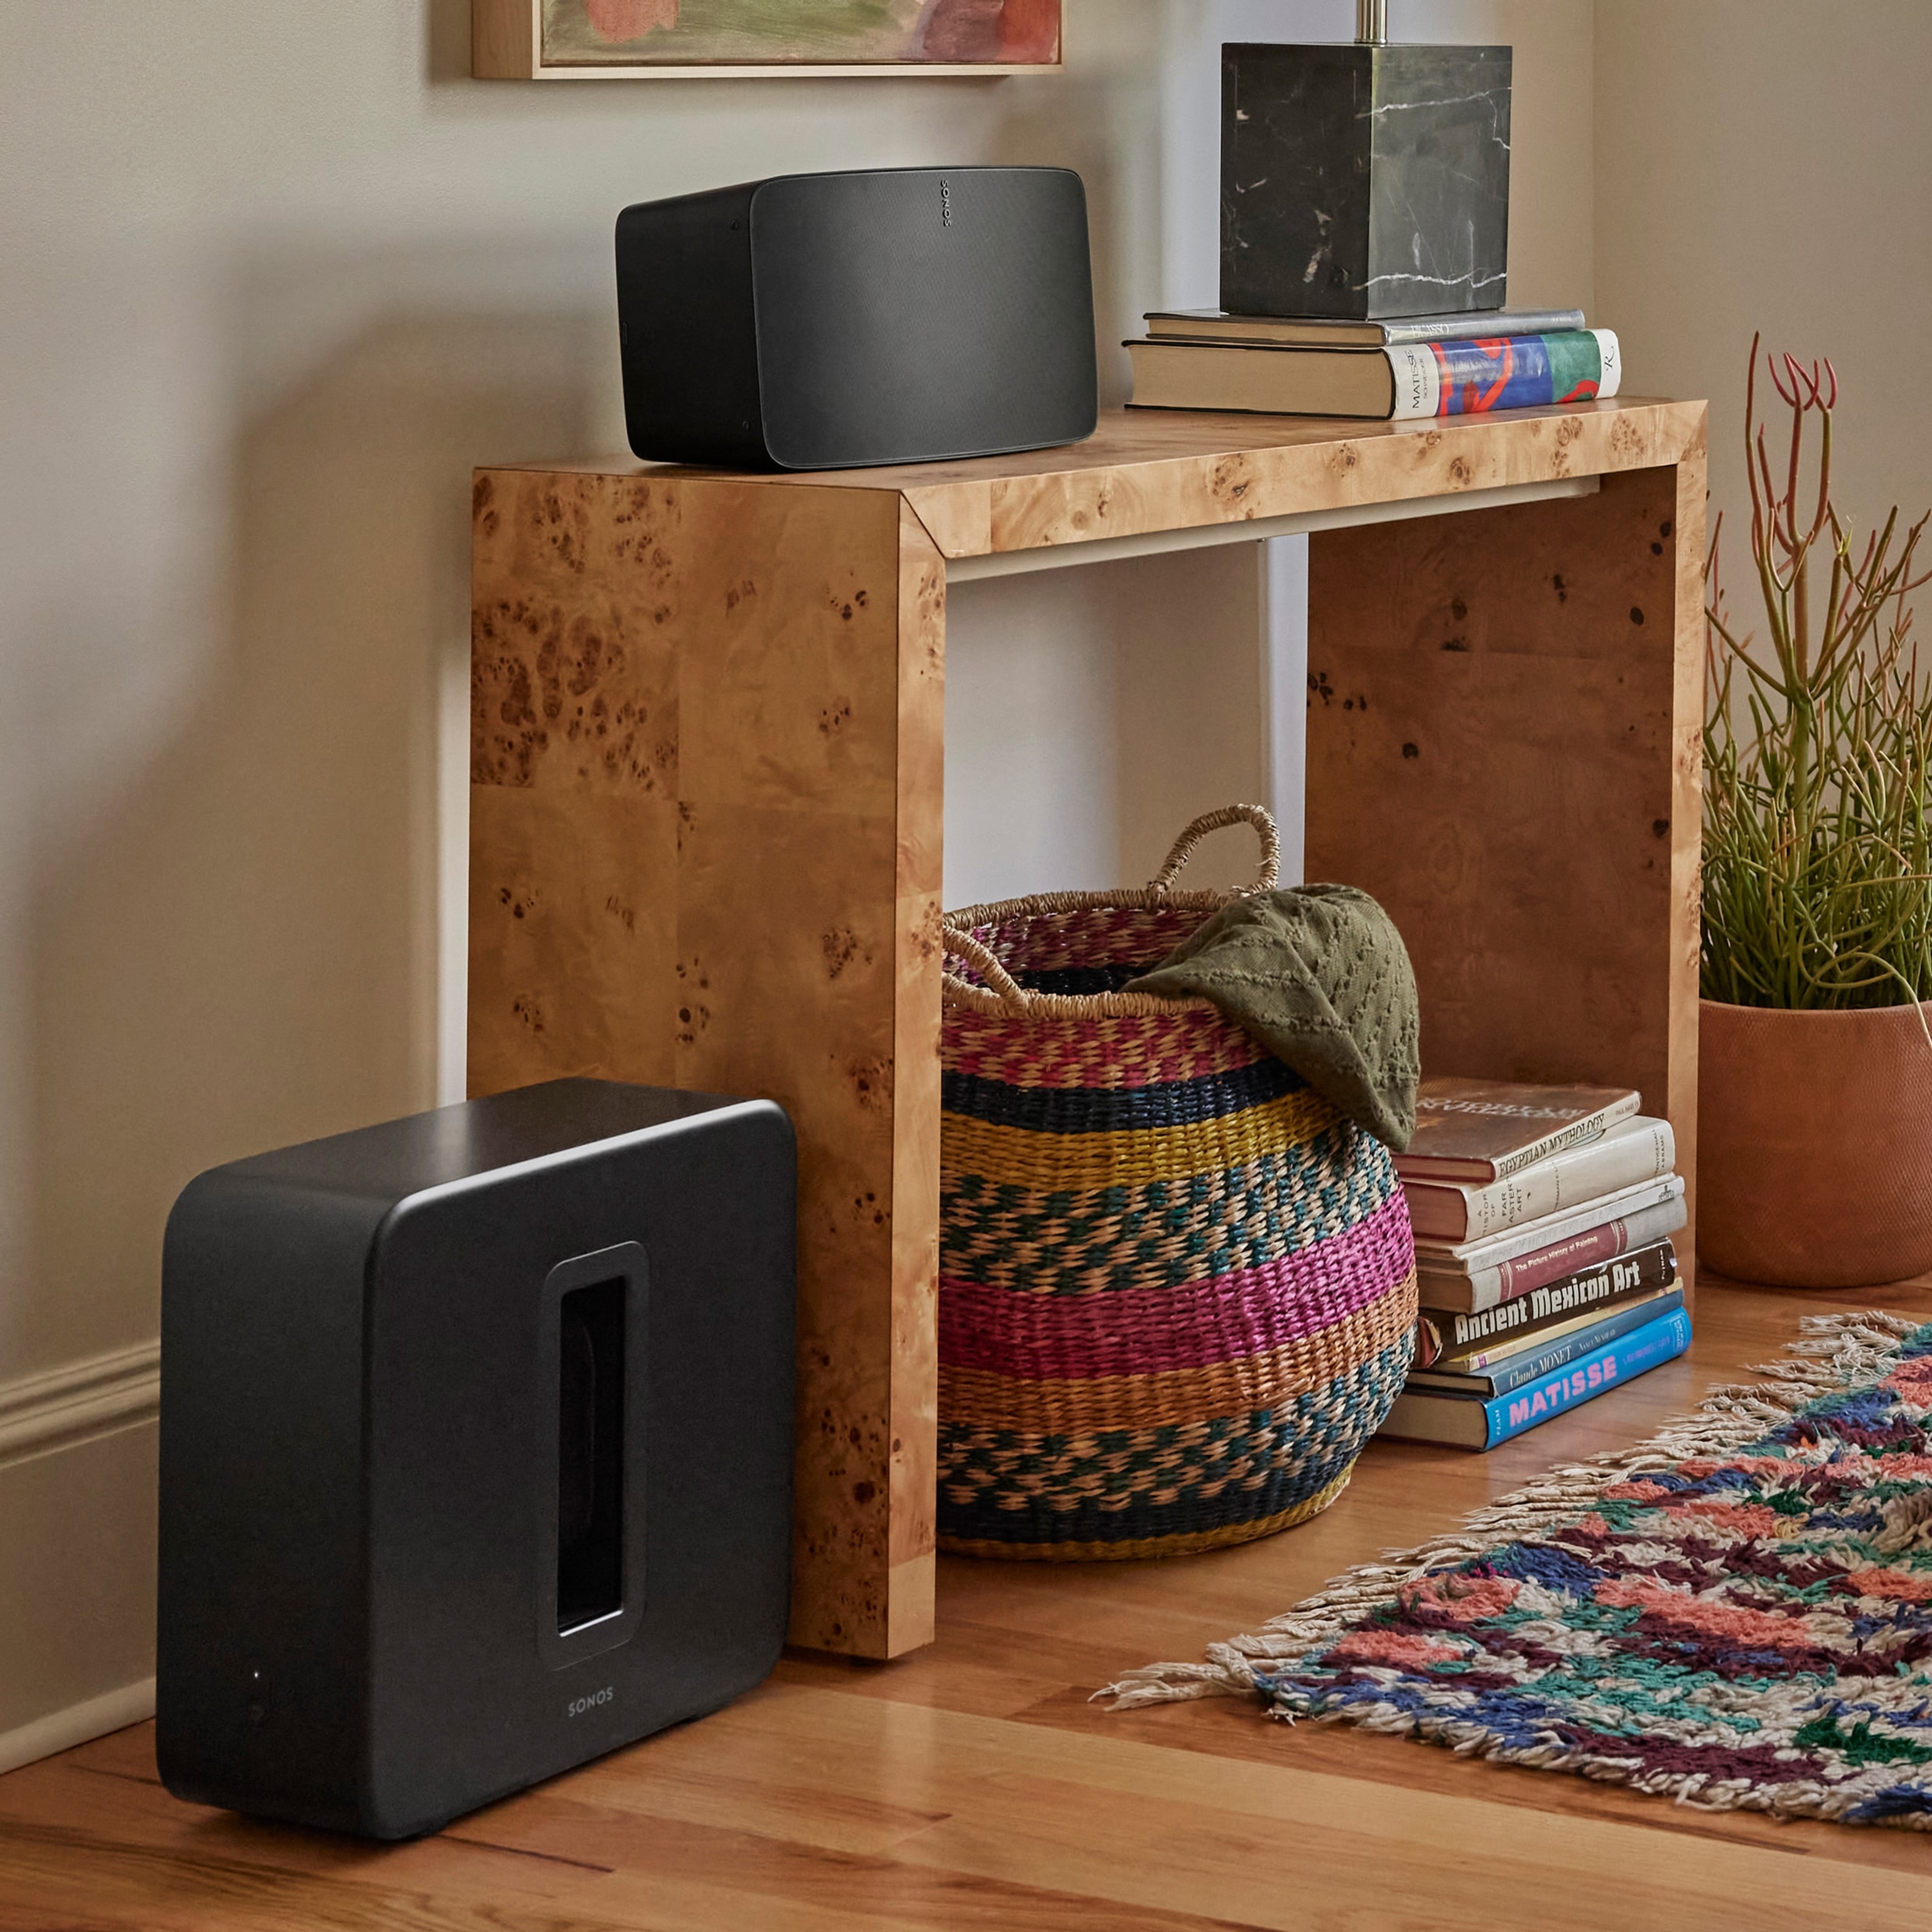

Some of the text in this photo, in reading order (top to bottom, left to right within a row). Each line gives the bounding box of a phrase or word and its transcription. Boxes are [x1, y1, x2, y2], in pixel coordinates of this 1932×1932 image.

[940, 180, 951, 226] SONOS
[1405, 349, 1420, 409] MATISSE
[1499, 1113, 1605, 1178] EGYPTIAN MYTHOLOGY
[1491, 1203, 1495, 1217] OF
[1515, 1236, 1598, 1272] The Picture History of Painting
[1455, 1297, 1527, 1344] Ancient
[1531, 1274, 1609, 1319] Mexican
[1612, 1261, 1640, 1293] Art
[1509, 1362, 1538, 1389] Claude
[1539, 1345, 1572, 1372] MONET
[1508, 1355, 1618, 1428] MATISSE
[568, 1686, 613, 1717] SONOS
